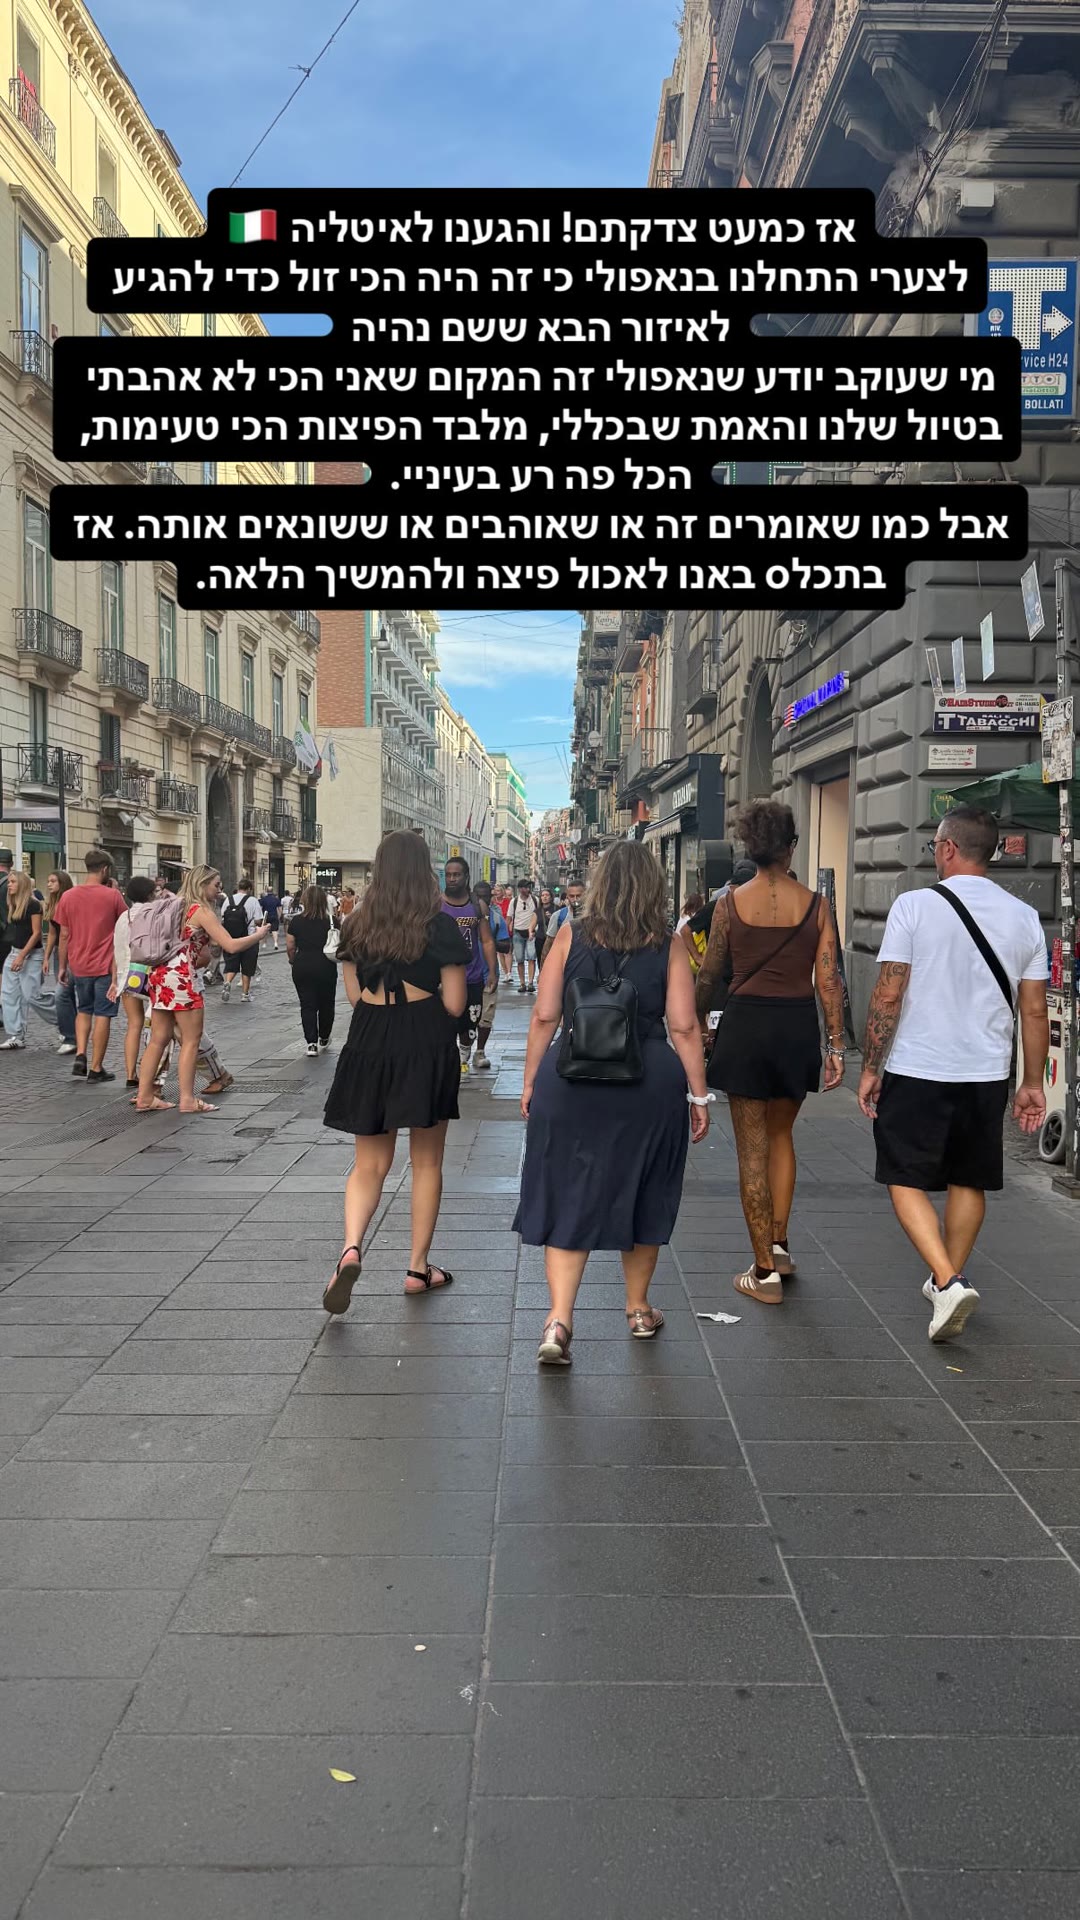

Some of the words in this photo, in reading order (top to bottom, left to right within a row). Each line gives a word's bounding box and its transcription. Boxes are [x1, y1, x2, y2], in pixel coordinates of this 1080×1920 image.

[989, 268, 1067, 349] T
[1048, 352, 1068, 368] H24
[1025, 399, 1064, 409] BOLLATI
[957, 714, 1035, 728] TABACCHI
